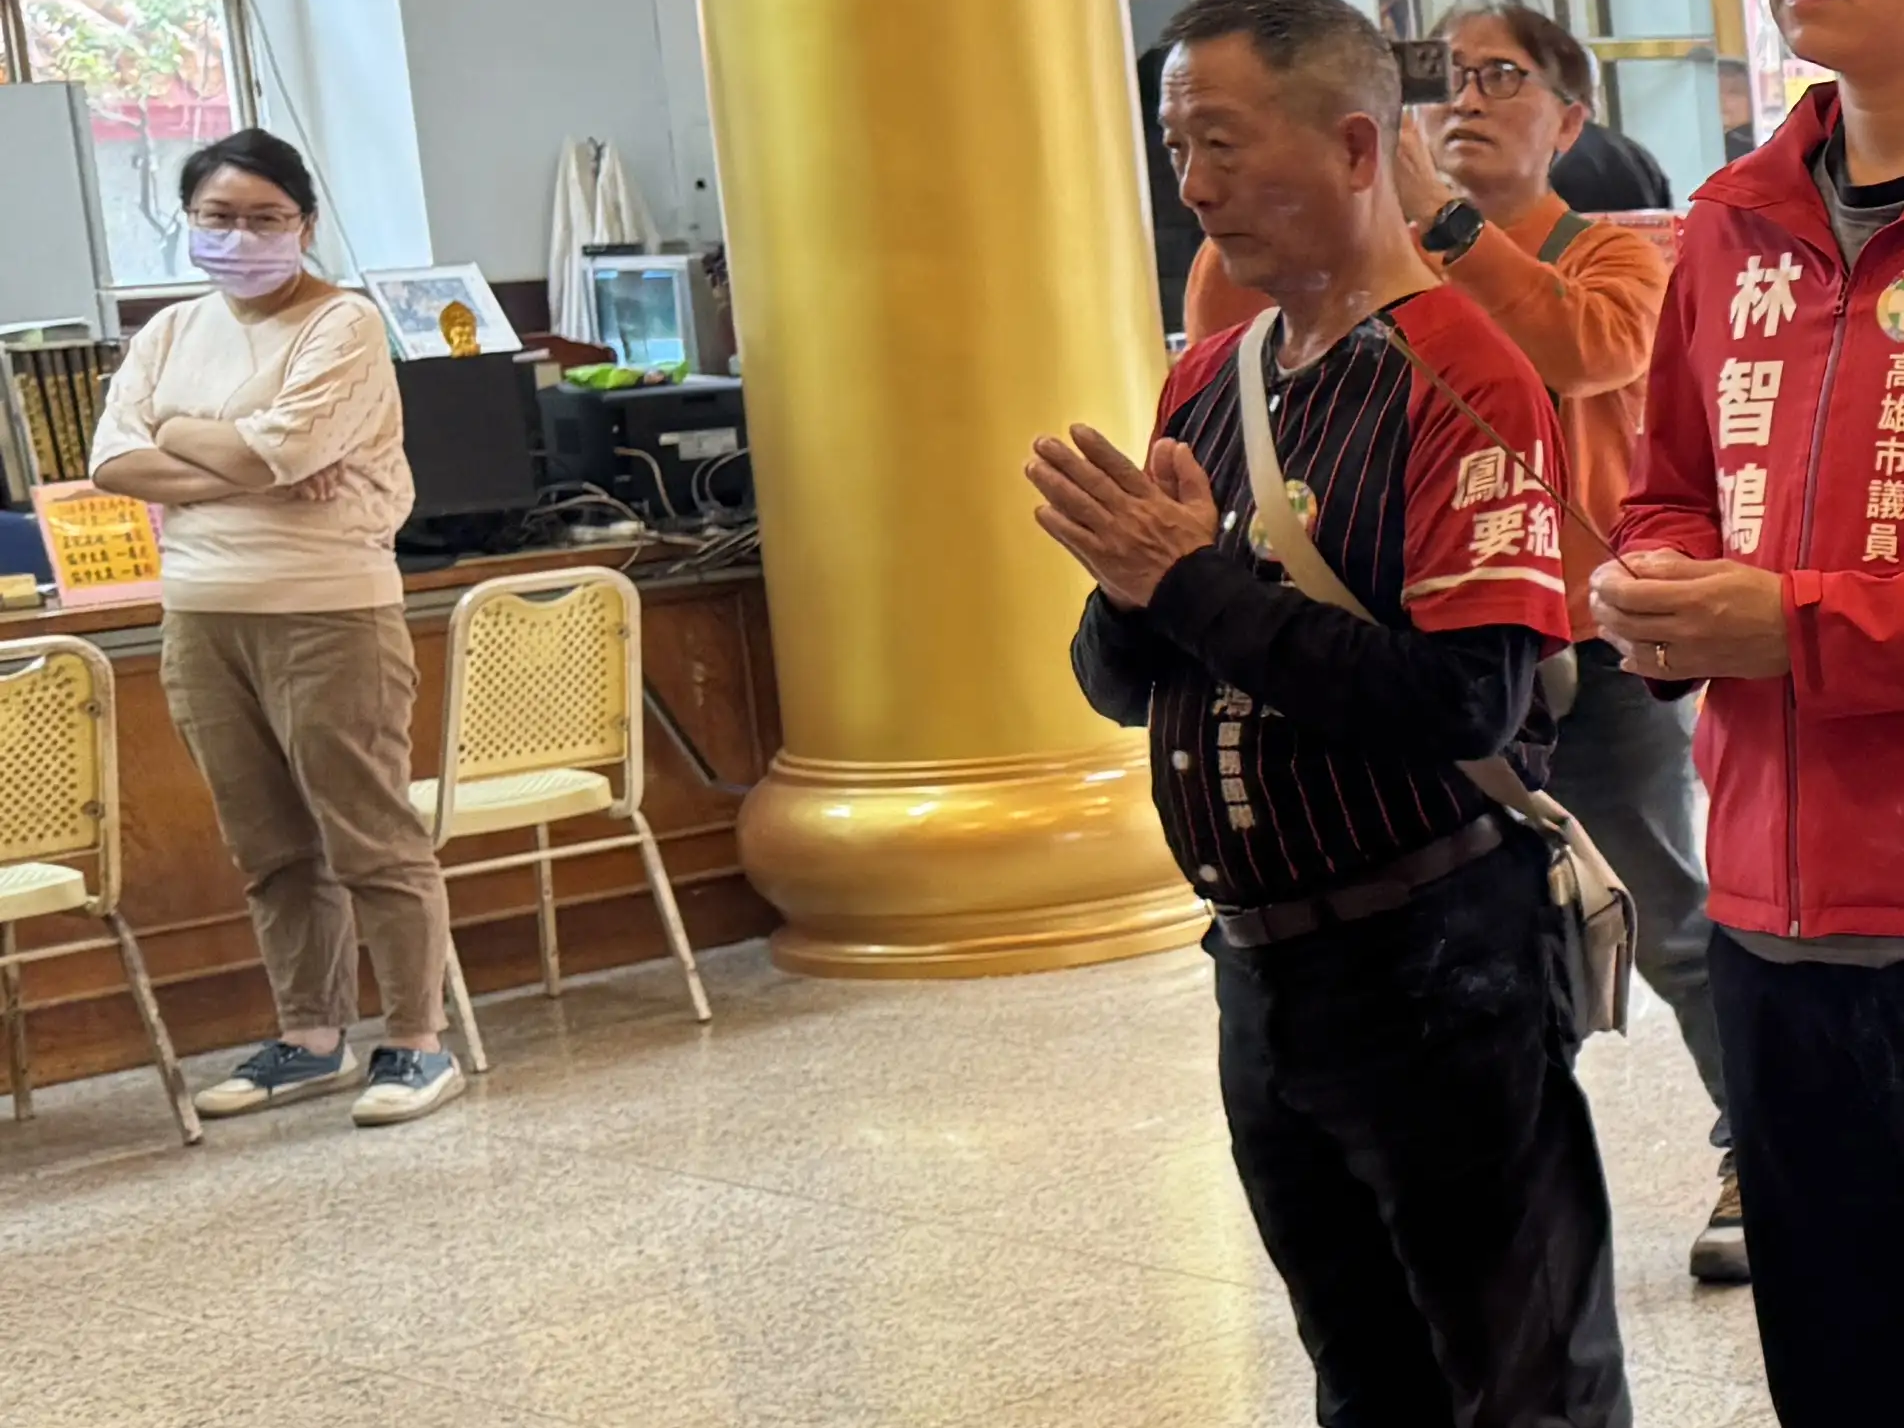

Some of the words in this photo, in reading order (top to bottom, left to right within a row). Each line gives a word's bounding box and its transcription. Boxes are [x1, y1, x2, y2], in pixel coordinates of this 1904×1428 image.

[1452, 439, 1553, 510] 鳳山
[1716, 251, 1804, 555] 林智鴻
